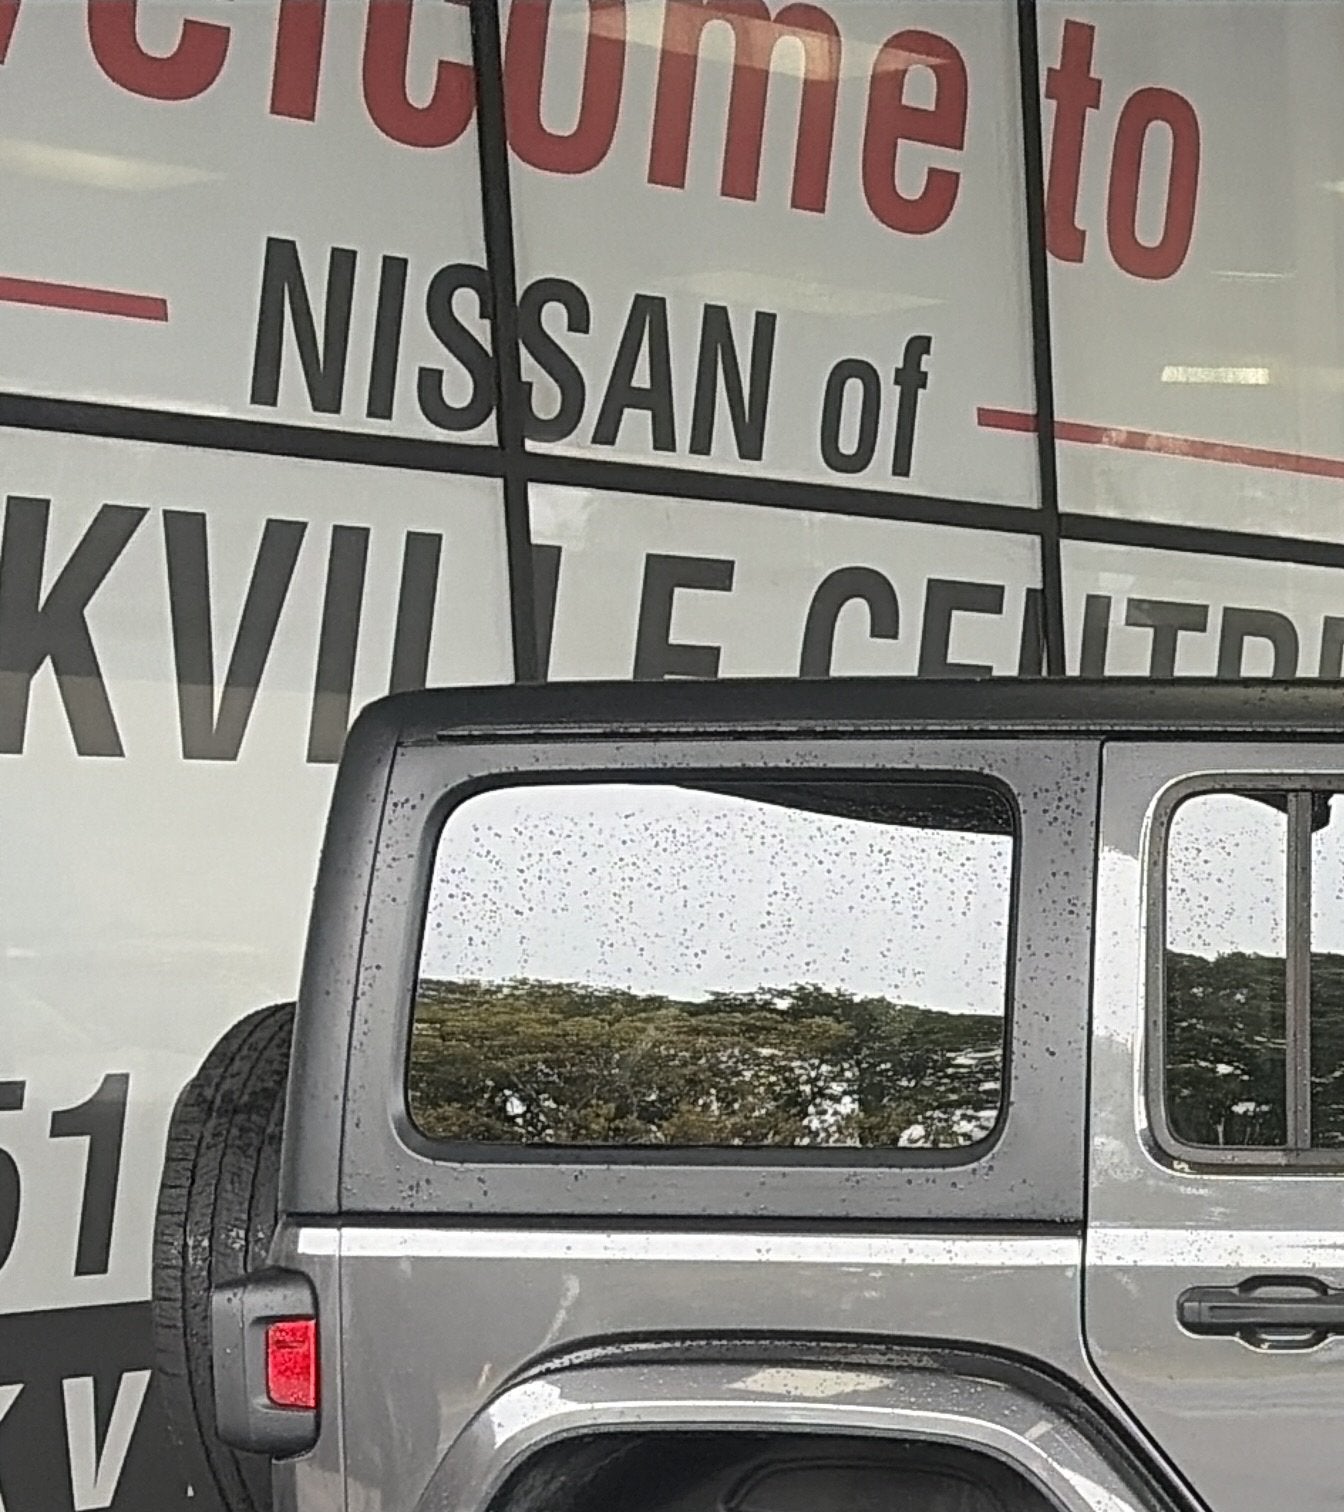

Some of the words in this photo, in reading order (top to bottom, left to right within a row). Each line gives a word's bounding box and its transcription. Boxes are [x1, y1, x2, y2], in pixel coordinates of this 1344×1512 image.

[0, 0, 970, 235] come
[1043, 18, 1203, 281] to
[250, 237, 778, 463] NISSAN
[818, 335, 934, 479] of
[0, 1072, 131, 1277] 1
